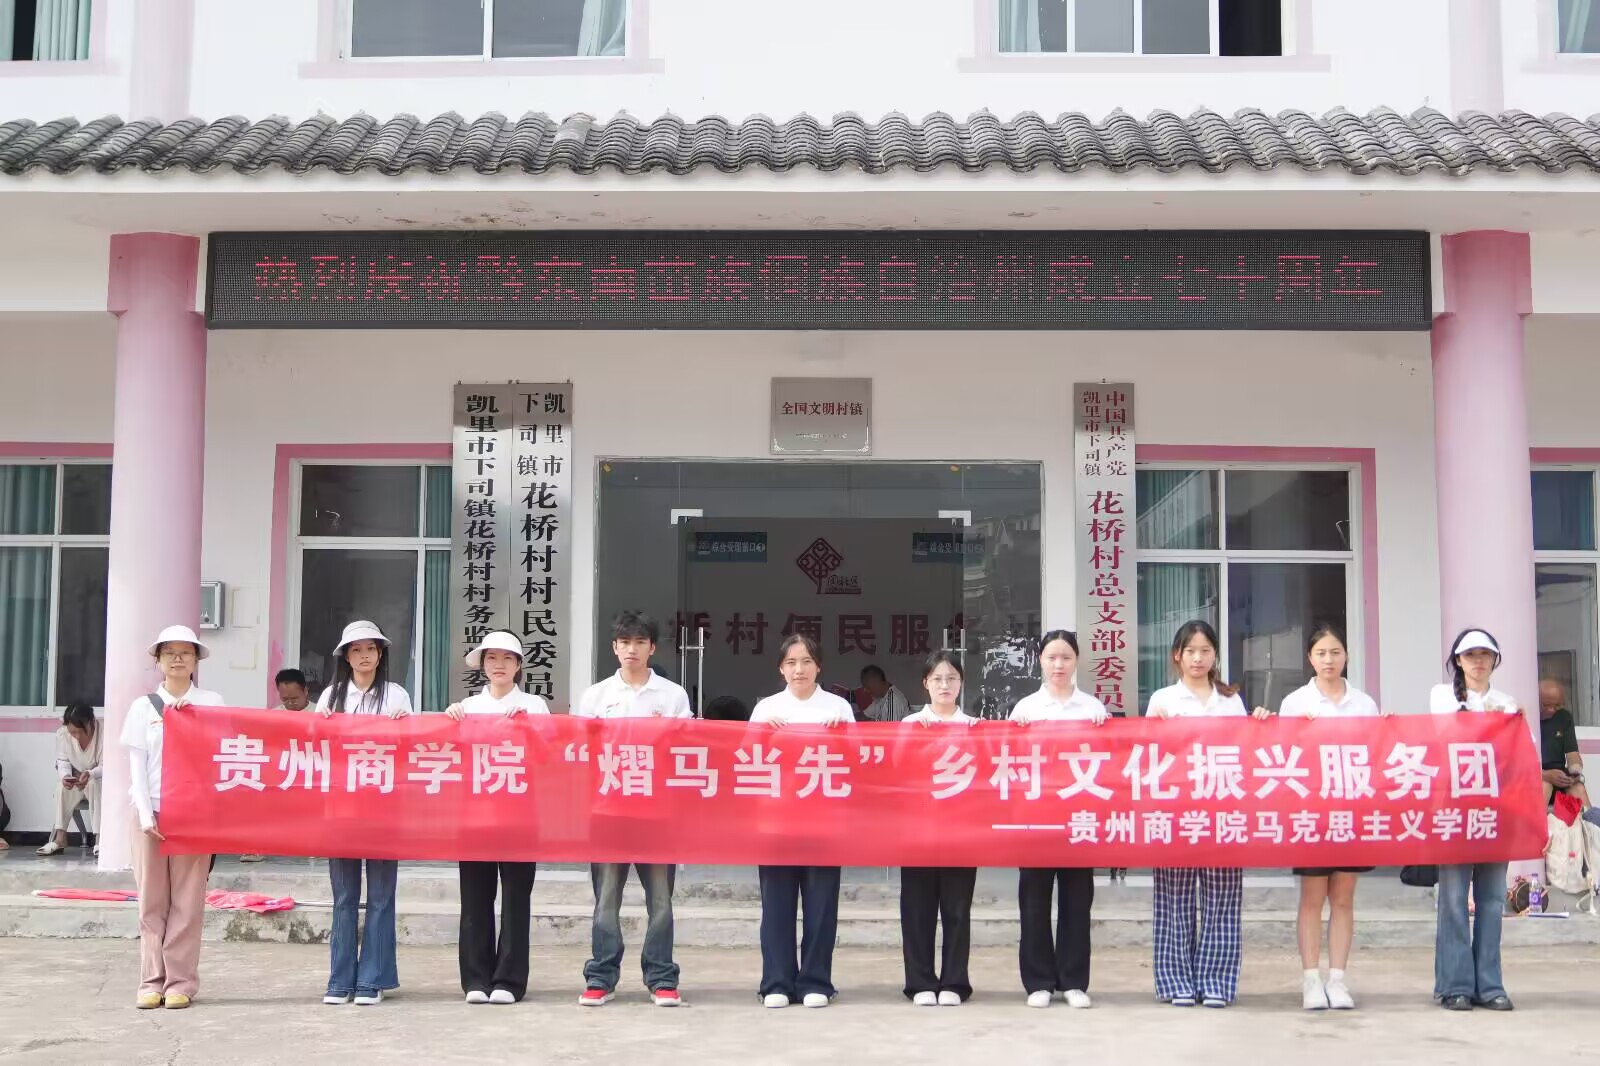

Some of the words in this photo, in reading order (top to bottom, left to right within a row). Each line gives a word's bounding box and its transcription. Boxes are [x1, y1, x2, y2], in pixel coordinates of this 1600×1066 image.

[517, 392, 538, 476] 下司镇
[542, 392, 566, 477] 凯里市
[781, 401, 863, 416] 全国文明村镇
[1081, 391, 1101, 476] 凯里市下司镇
[1105, 390, 1128, 476] 中国共产党
[462, 393, 499, 697] 凯里市下司镇花桥村村务监委
[1086, 490, 1126, 709] 花桥村总支部委员
[212, 733, 529, 795] 贵州商学院
[562, 741, 885, 800] “熠马当先”
[930, 741, 1501, 801] 乡村文化振兴服务团
[990, 806, 1499, 846] ——贵州商学院马克思主义学院
